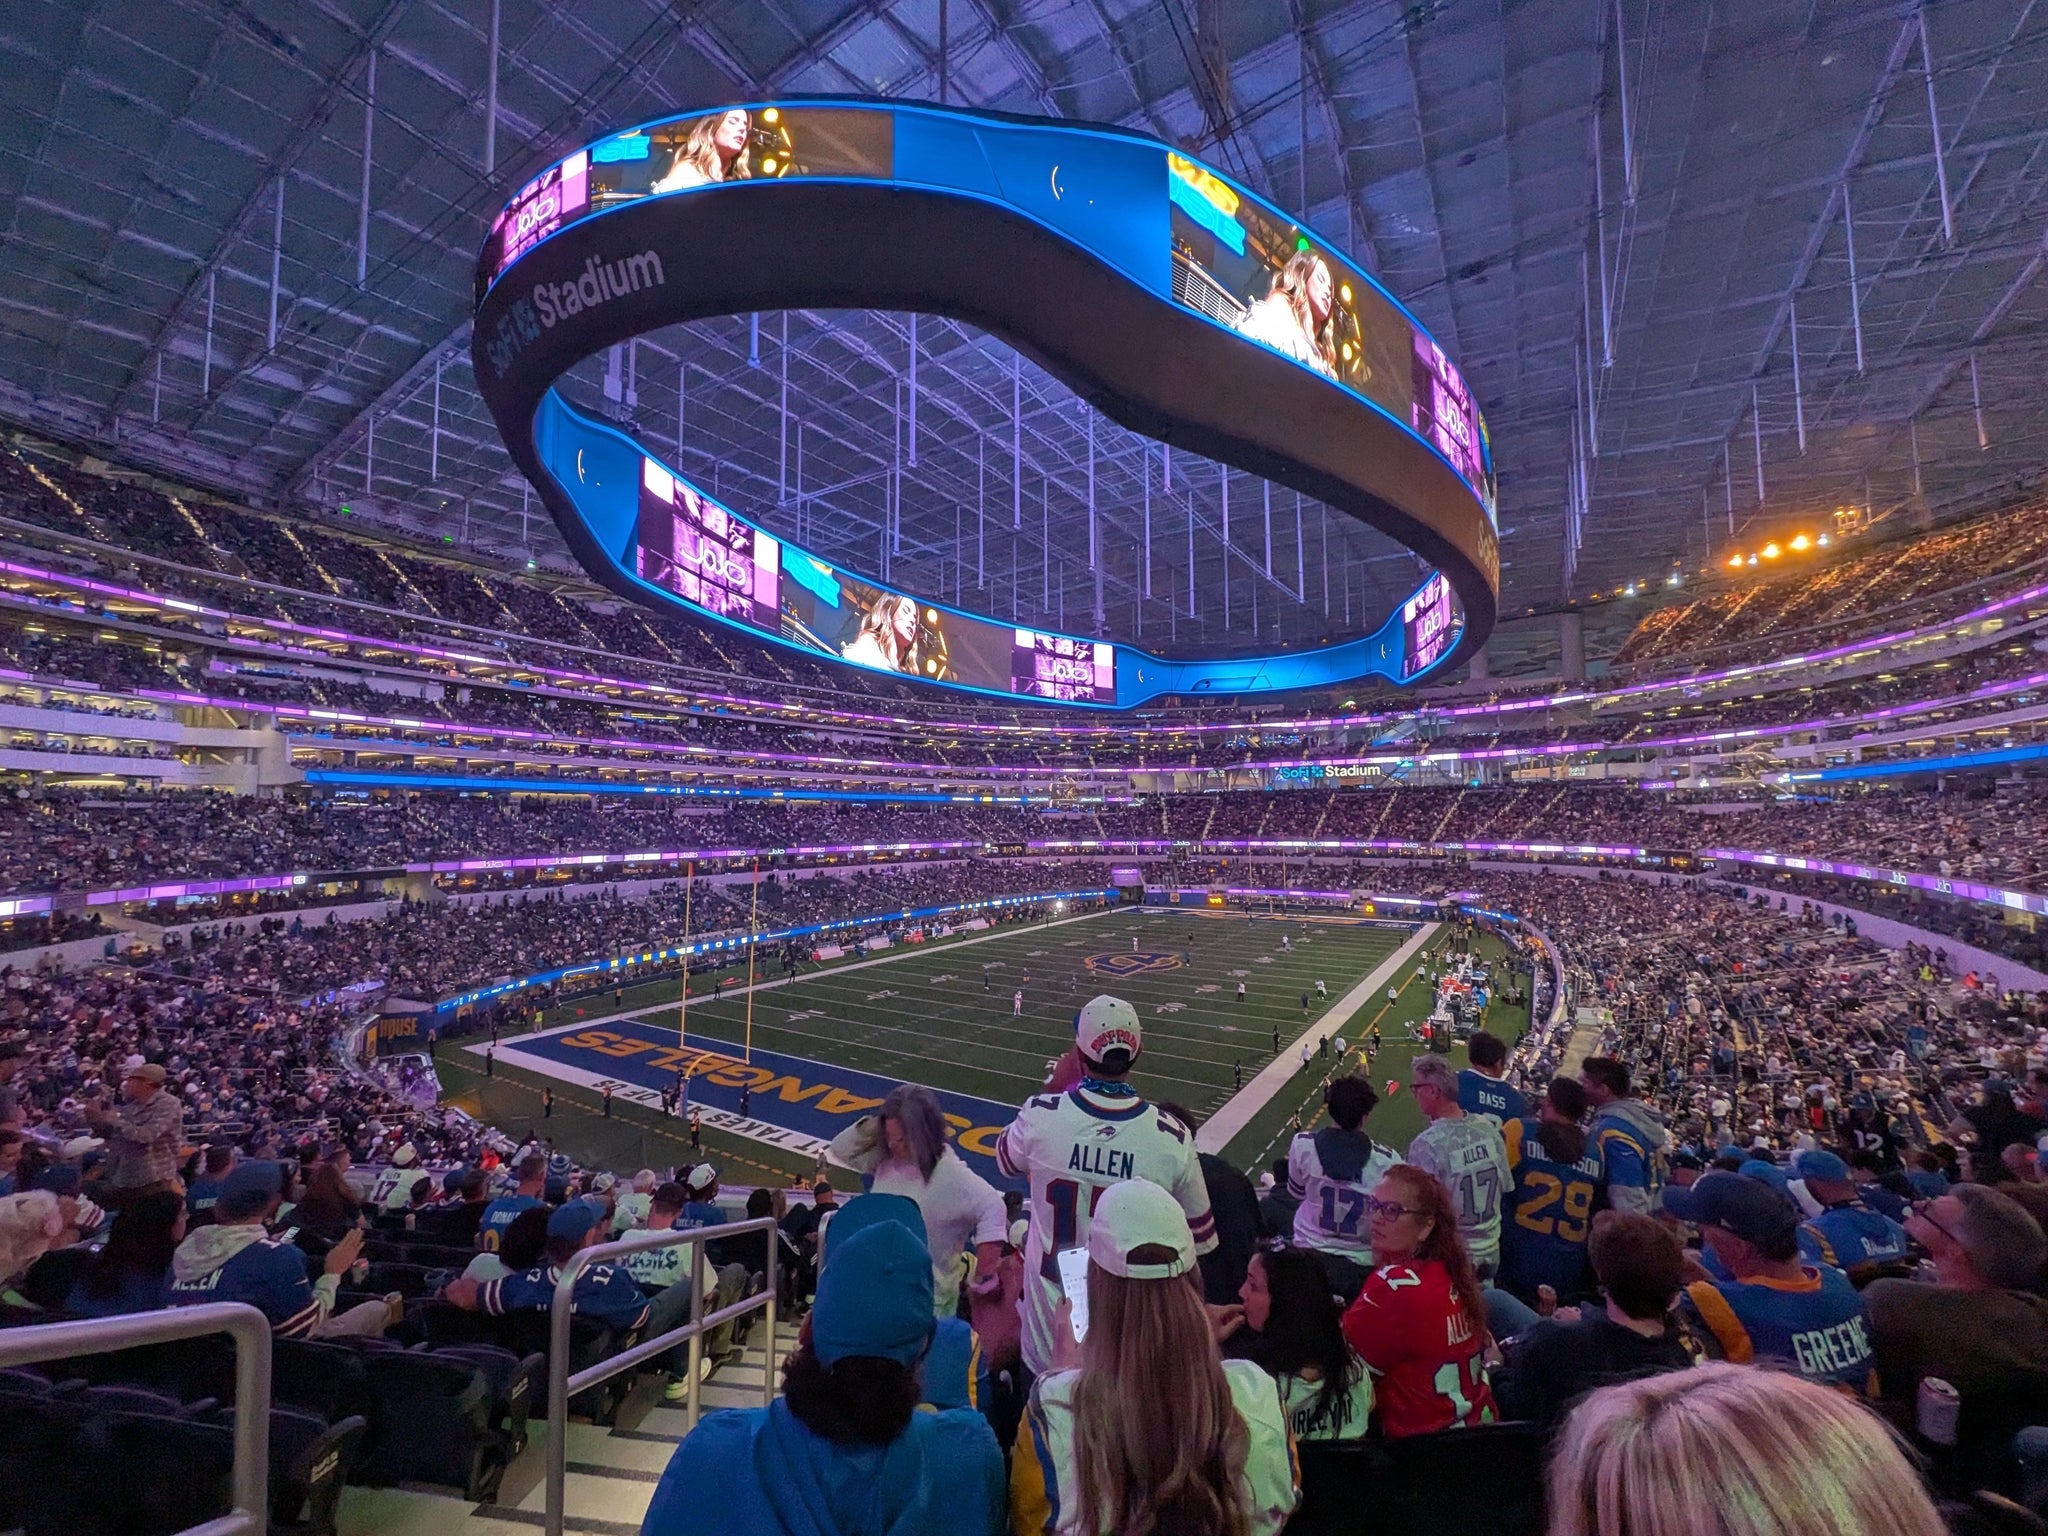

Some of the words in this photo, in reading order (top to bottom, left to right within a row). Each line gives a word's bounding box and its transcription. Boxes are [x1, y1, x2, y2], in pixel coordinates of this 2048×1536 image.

[533, 250, 665, 329] Stadium
[1282, 767, 1310, 779] SoFi
[1325, 765, 1381, 778] Stadium
[610, 951, 667, 968] RAMS
[702, 934, 760, 951] HOUSE
[379, 1017, 418, 1038] HOUSE
[559, 1030, 888, 1114] ANGELES
[1478, 1090, 1507, 1110] BASS
[706, 1112, 793, 1144] TAKES
[1068, 1143, 1135, 1180] ALLEN
[1463, 1143, 1490, 1166] ALLEN
[373, 1180, 399, 1202] 17
[1458, 1166, 1499, 1227] 17
[1514, 1171, 1595, 1243] 29
[1318, 1185, 1365, 1235] 17
[1791, 1314, 1873, 1374] GREENE
